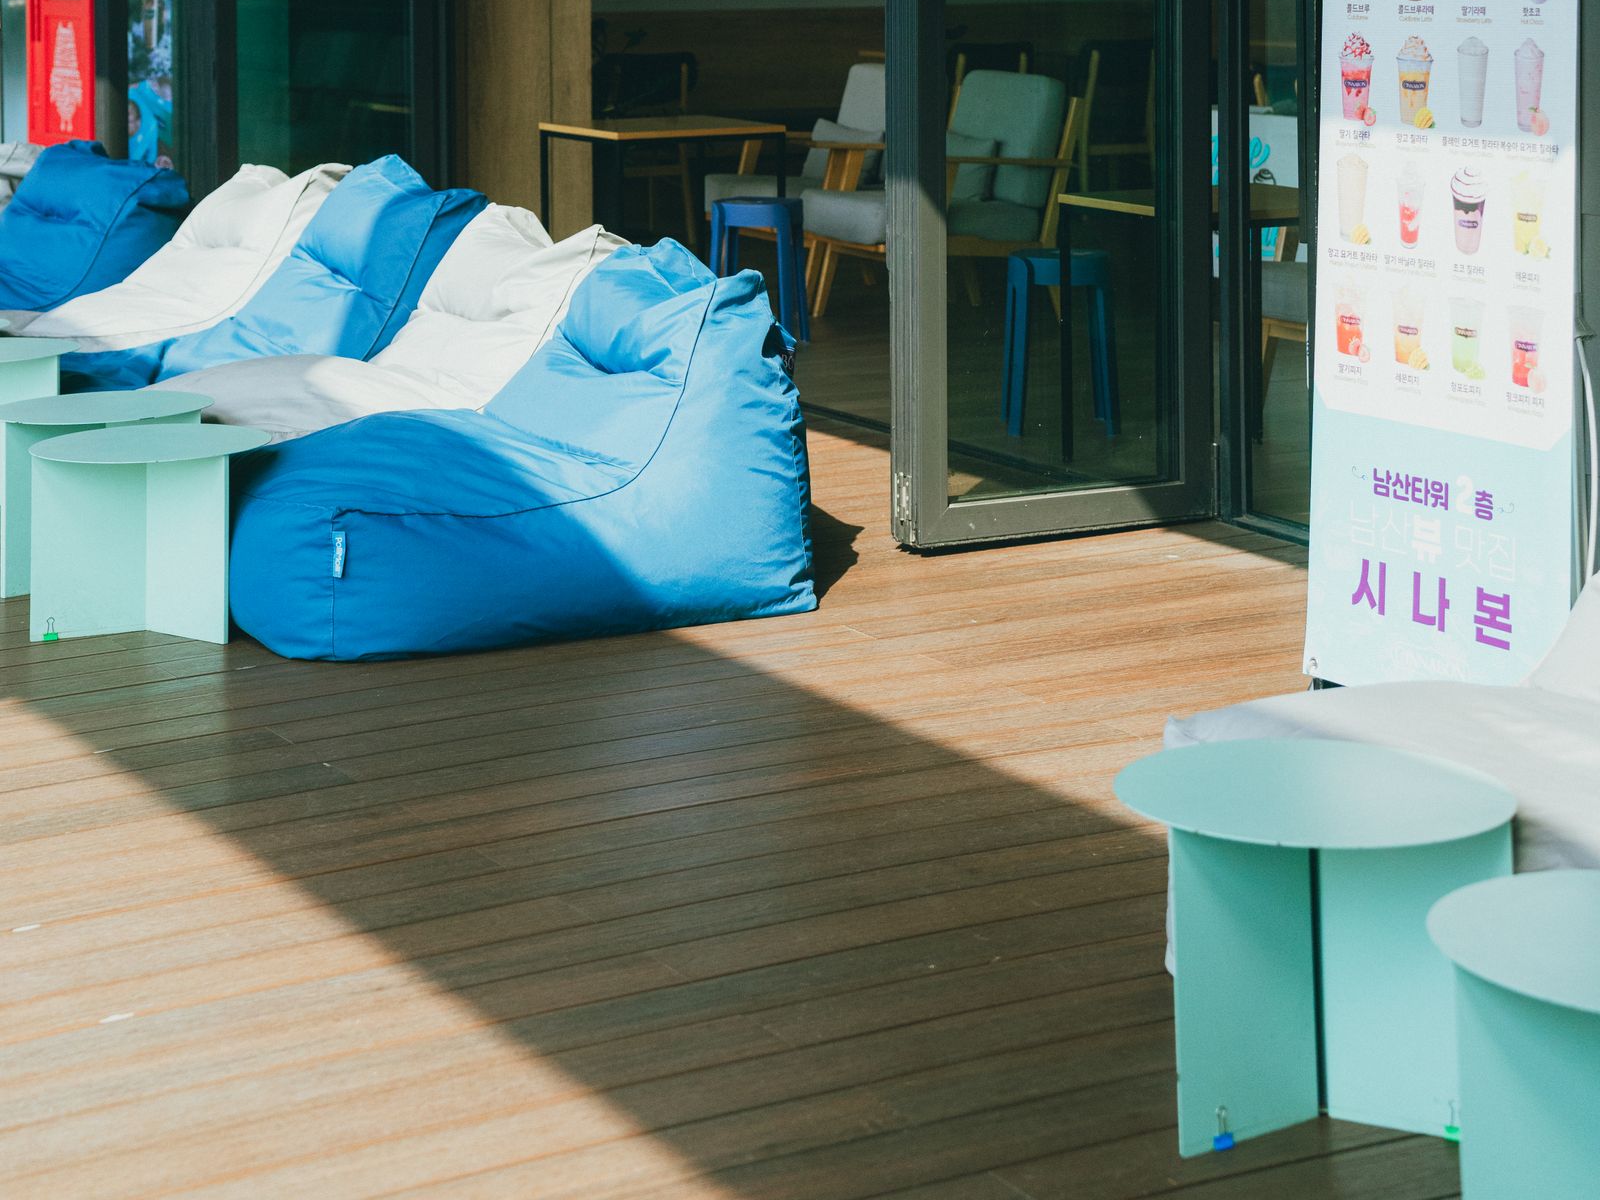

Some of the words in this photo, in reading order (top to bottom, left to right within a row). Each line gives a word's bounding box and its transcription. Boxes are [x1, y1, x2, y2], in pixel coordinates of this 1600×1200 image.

[1372, 467, 1449, 511] 남산타워
[1349, 498, 1443, 565] 남산뷰
[1456, 524, 1517, 582] 맛집
